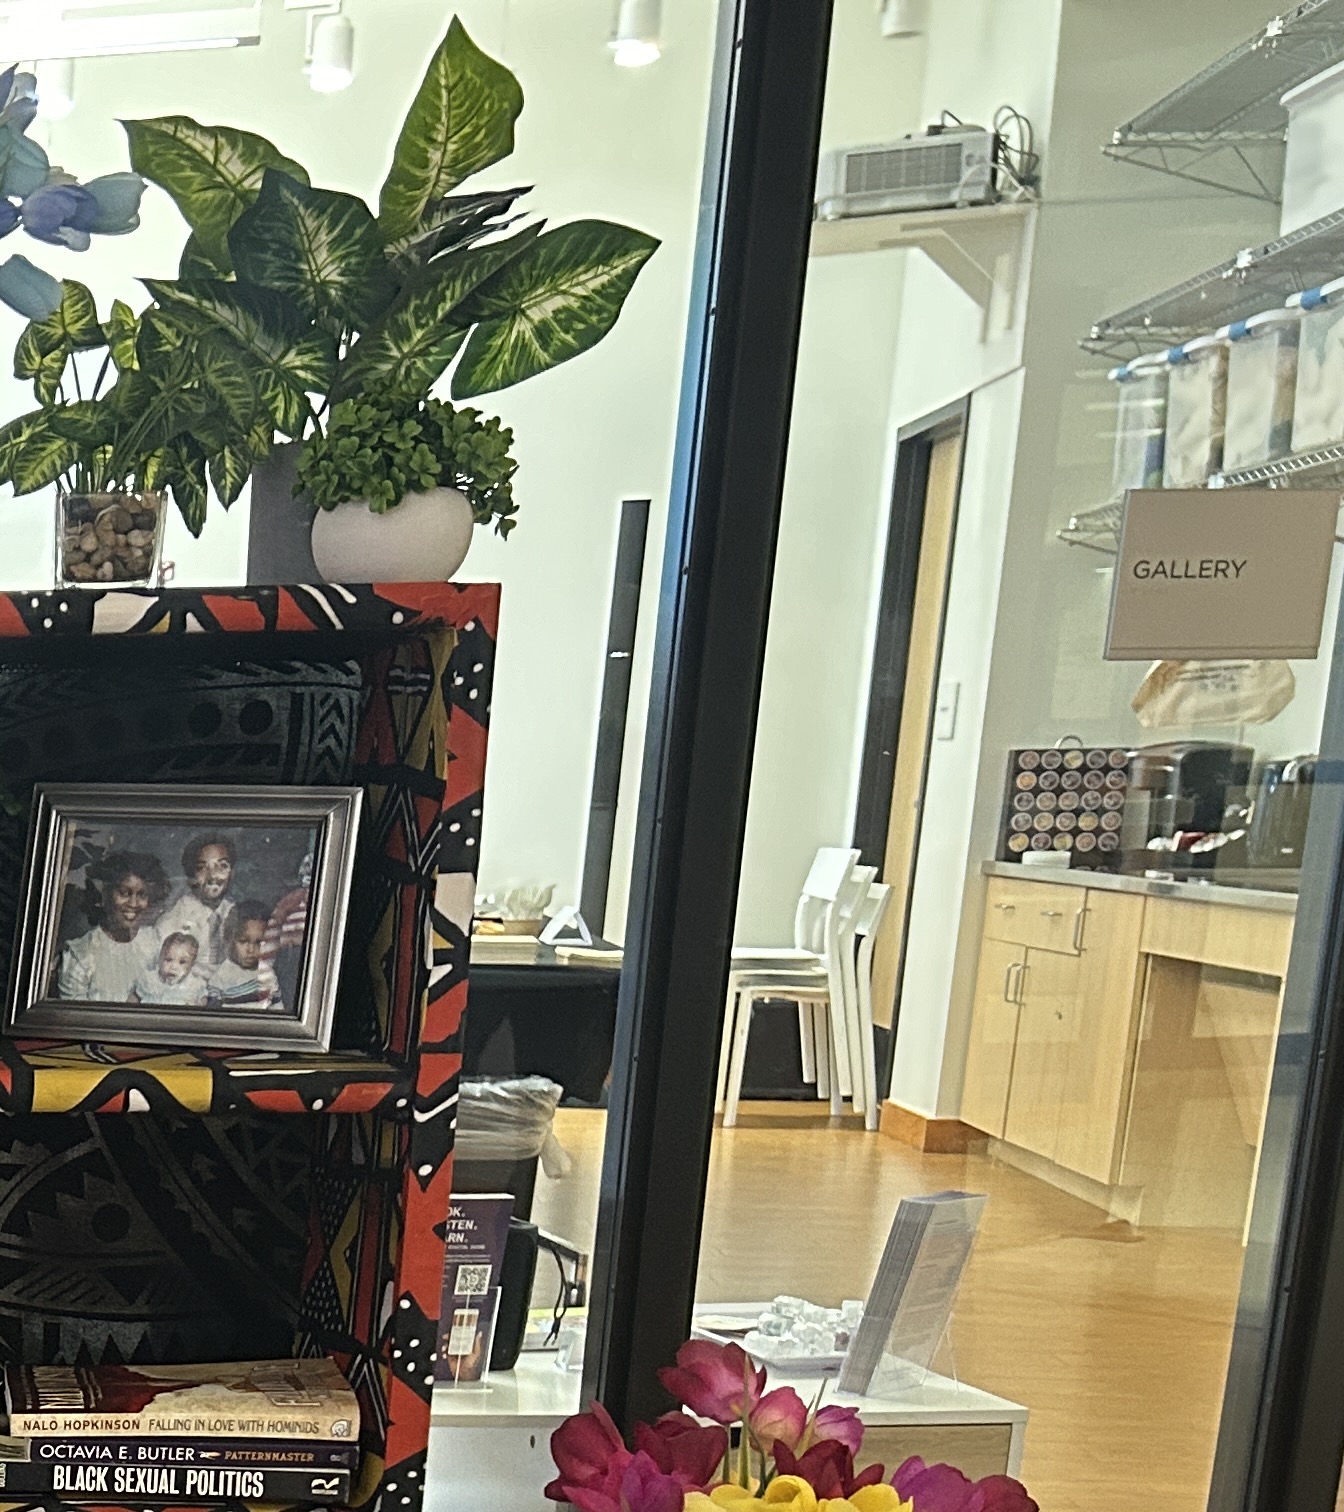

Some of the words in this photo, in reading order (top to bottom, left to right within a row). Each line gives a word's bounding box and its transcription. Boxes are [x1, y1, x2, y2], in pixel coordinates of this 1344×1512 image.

[1133, 559, 1248, 580] GALLERY
[23, 1420, 58, 1431] NALO
[63, 1419, 141, 1431] HOPKINSON
[149, 1418, 192, 1431] FALLING
[194, 1419, 205, 1431] IN
[208, 1419, 234, 1432] LOVE
[237, 1420, 265, 1433] WITH
[266, 1420, 320, 1434] HOMINIDS
[39, 1444, 112, 1460] OCTAVIA
[118, 1446, 133, 1460] E.
[137, 1446, 195, 1461] BUTLER
[224, 1451, 315, 1462] PATTERNMASTER
[53, 1465, 108, 1492] BLACK
[114, 1466, 180, 1495] SEXUAL
[185, 1469, 264, 1498] POLITICS
